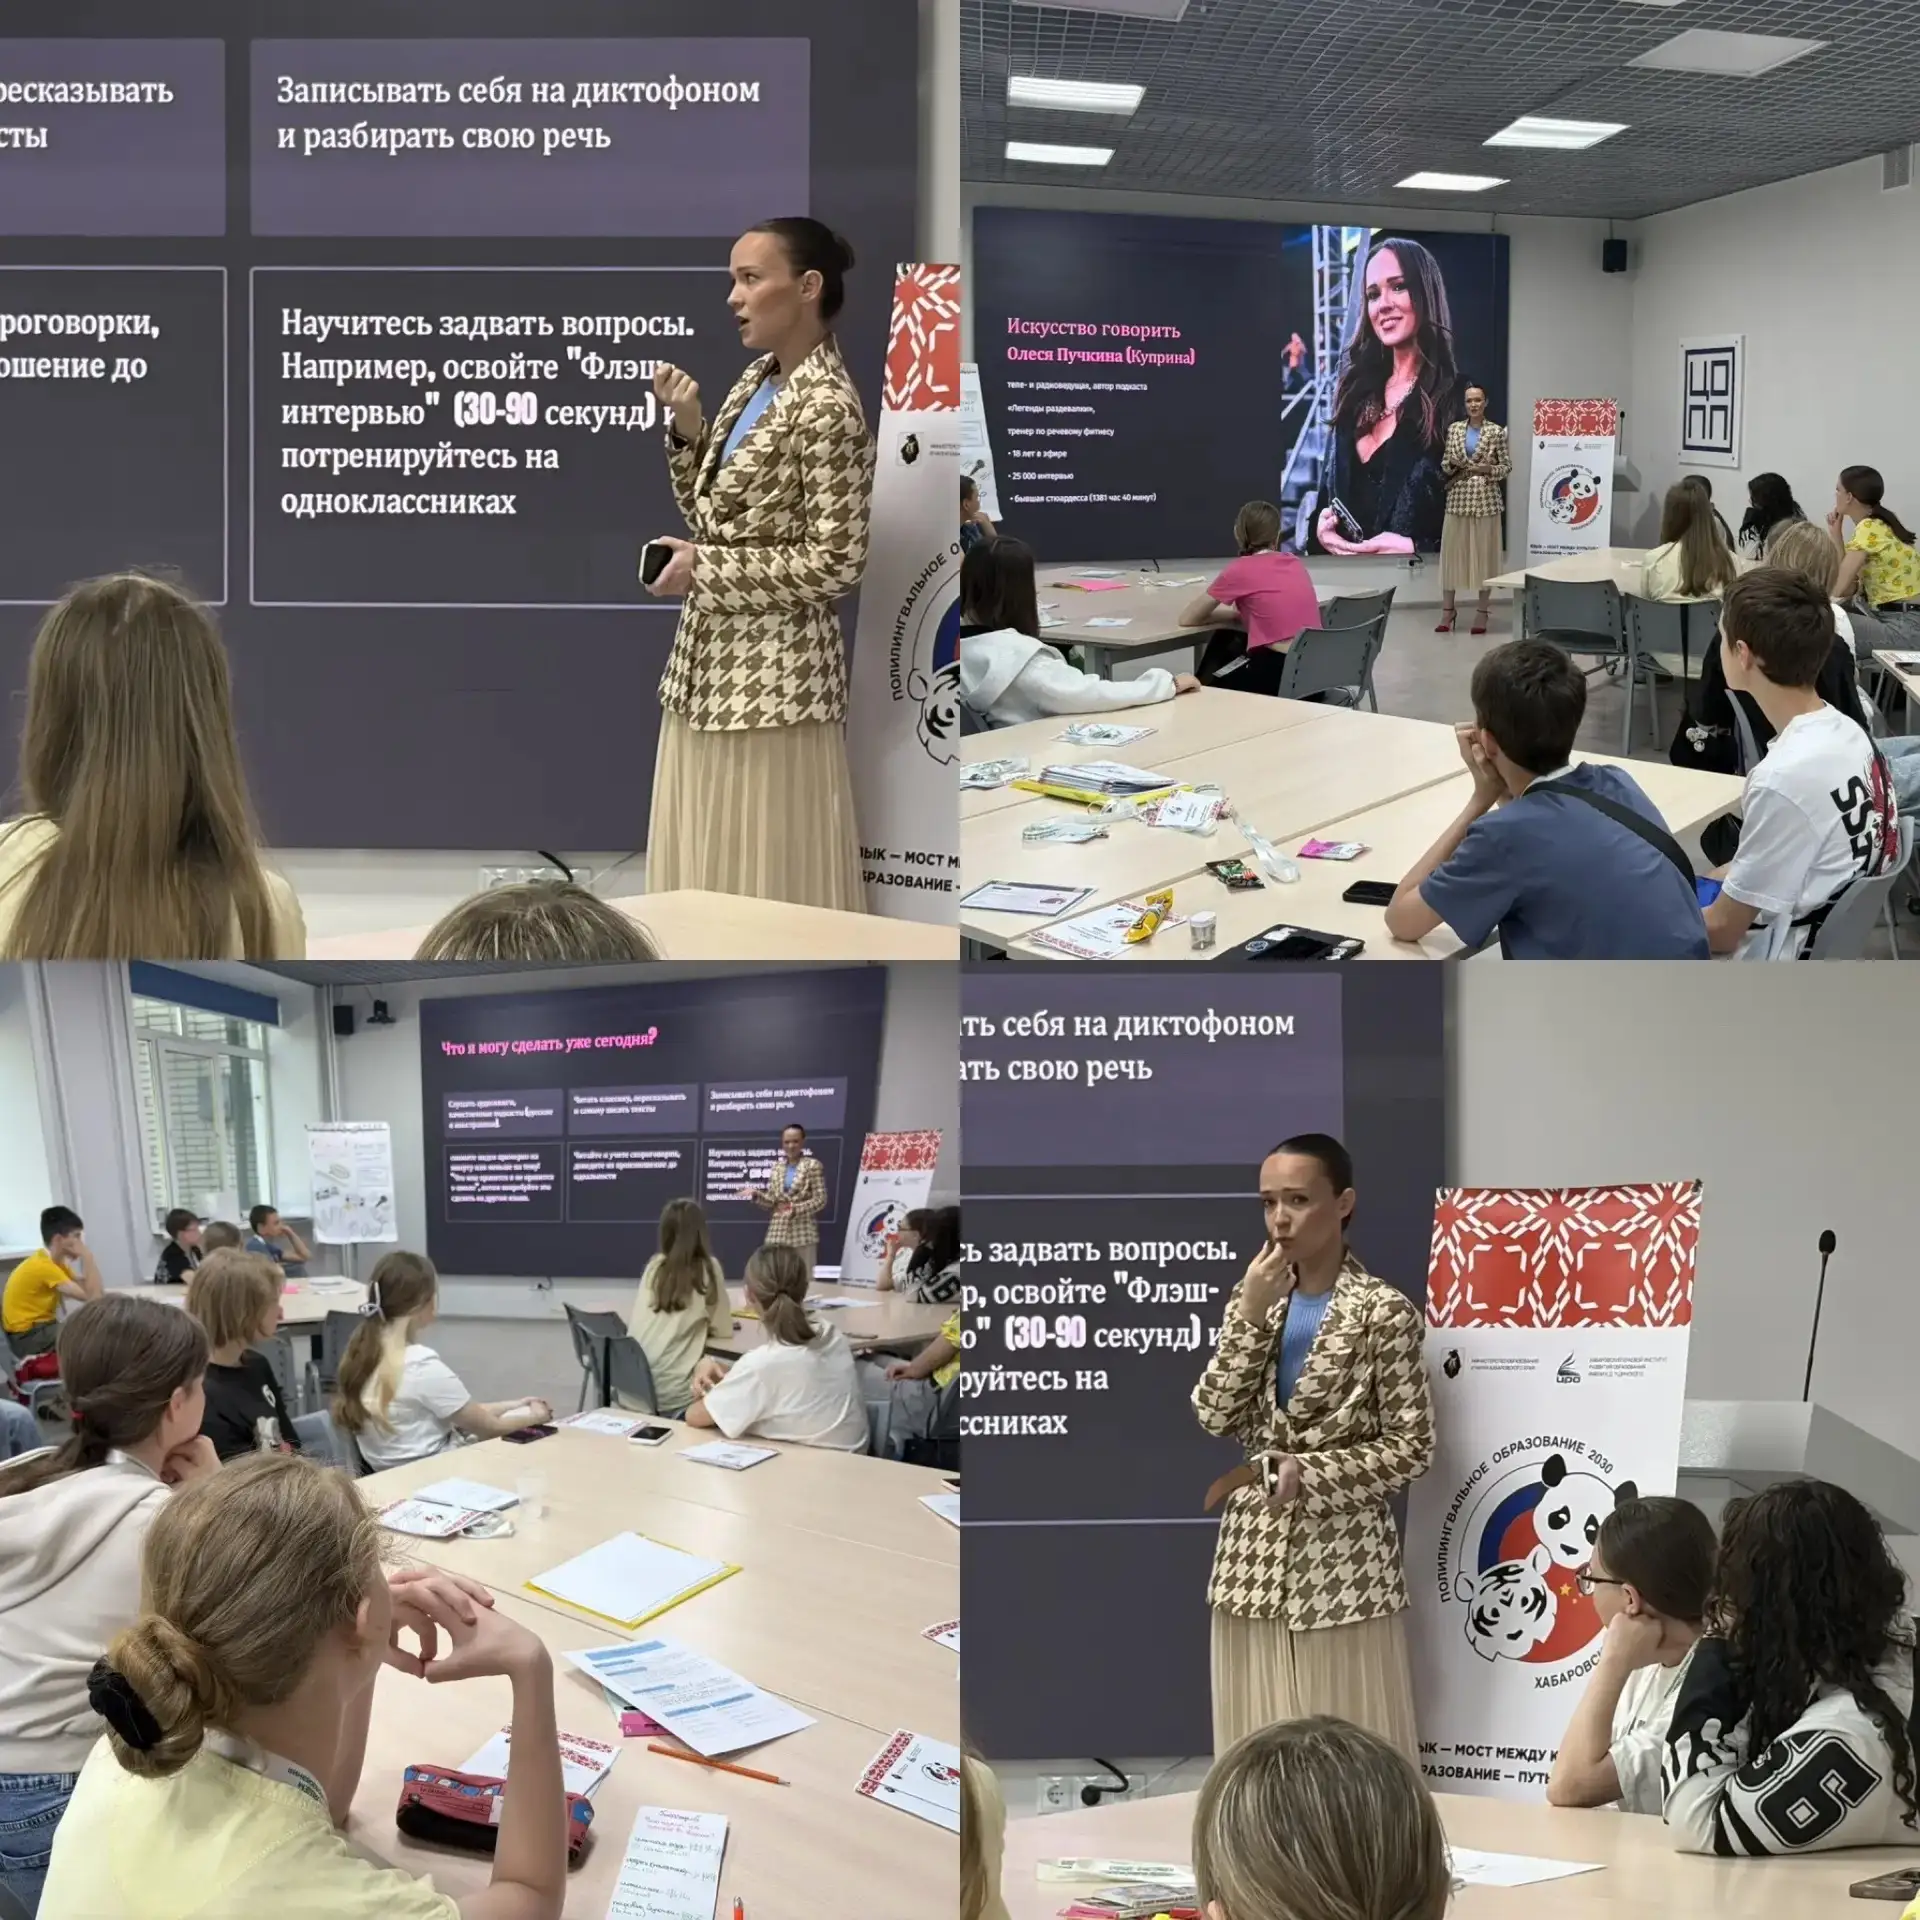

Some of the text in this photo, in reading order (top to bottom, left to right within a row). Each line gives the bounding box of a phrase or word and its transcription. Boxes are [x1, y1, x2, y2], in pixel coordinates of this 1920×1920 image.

[277, 73, 760, 110] Записывать себя на диктофоном
[277, 121, 611, 156] и разбирать свою речь
[0, 314, 160, 342] роговорки,
[282, 308, 694, 343] Научитесь задвать вопросы.
[1007, 317, 1181, 341] Искусство говорить
[111, 357, 147, 383] до
[282, 352, 436, 387] Например,
[443, 352, 558, 380] освойте
[1007, 346, 1196, 367] Олеся Пучкина (Куприна)
[1092, 383, 1114, 392] автор
[281, 391, 440, 432] интервью"
[454, 390, 537, 428] (30-90
[545, 391, 656, 433] секунд)
[1007, 428, 1034, 437] тренер
[1036, 428, 1045, 436] по
[281, 441, 559, 475] потренируйтесь на
[1012, 450, 1021, 458] 18
[1043, 450, 1068, 459] эфире
[1012, 472, 1021, 480] 25
[1022, 472, 1036, 480] 000
[281, 493, 517, 518] одноклассниках
[1122, 493, 1131, 501] 40
[904, 851, 944, 867] МОСТ
[948, 856, 960, 869] М
[1002, 1009, 1065, 1036] себя
[1074, 1016, 1108, 1036] на
[1113, 1008, 1295, 1043] диктофоном
[442, 1026, 658, 1056] Что я могу сделать уже сегодня?
[1007, 1059, 1079, 1080] свою
[1086, 1059, 1153, 1087] речь
[988, 1242, 1101, 1267] задвать
[1108, 1241, 1237, 1267] вопросы.
[993, 1277, 1106, 1304] освойте
[1113, 1270, 1219, 1303] "Флэш-
[1004, 1315, 1087, 1351] (30-90
[1094, 1313, 1201, 1354] секунд)
[1075, 1369, 1109, 1390] на
[1492, 1435, 1586, 1465] ОБРАЗОВАНИЕ
[1587, 1449, 1614, 1475] 2030
[1455, 1744, 1493, 1757] МОСТ
[1496, 1747, 1546, 1762] МЕЖДУ
